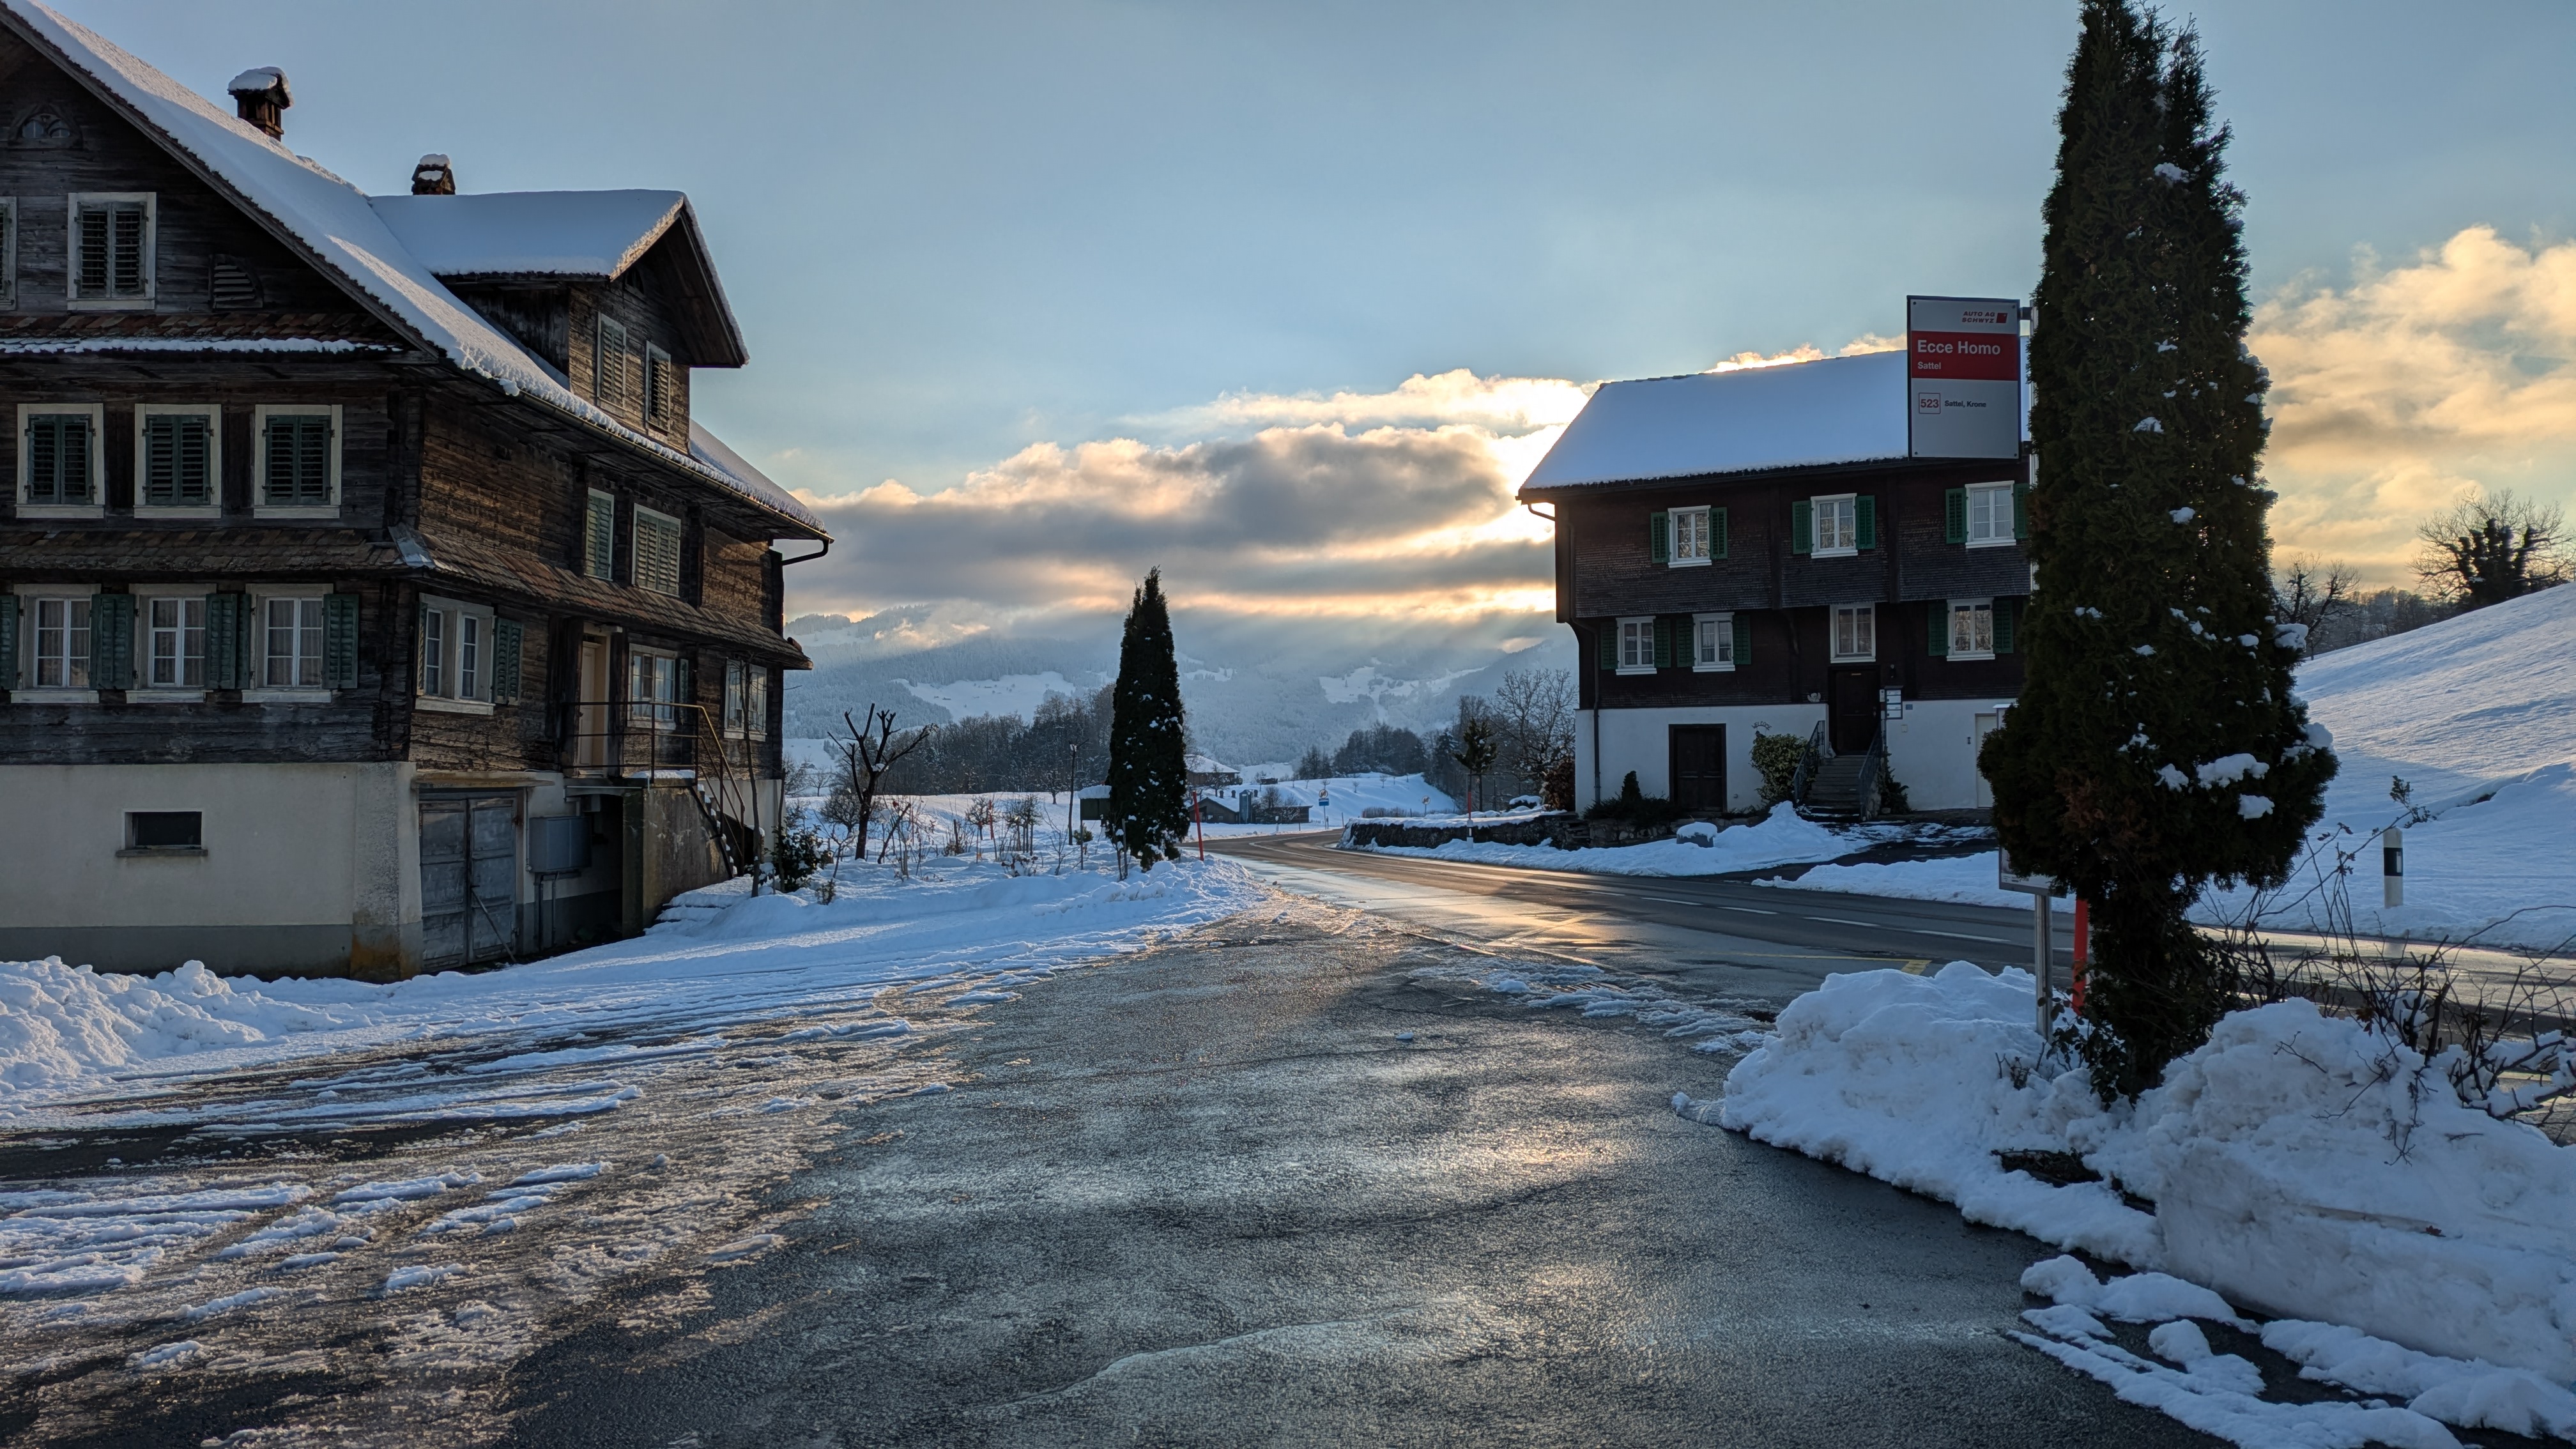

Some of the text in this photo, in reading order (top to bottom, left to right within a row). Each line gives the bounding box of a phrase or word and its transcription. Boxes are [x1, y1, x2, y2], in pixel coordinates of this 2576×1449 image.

[1917, 339, 2001, 355] Ecce Homo
[1917, 361, 1942, 370] Sattel
[1920, 399, 1939, 408] 523
[1944, 400, 1965, 408] Sattel,
